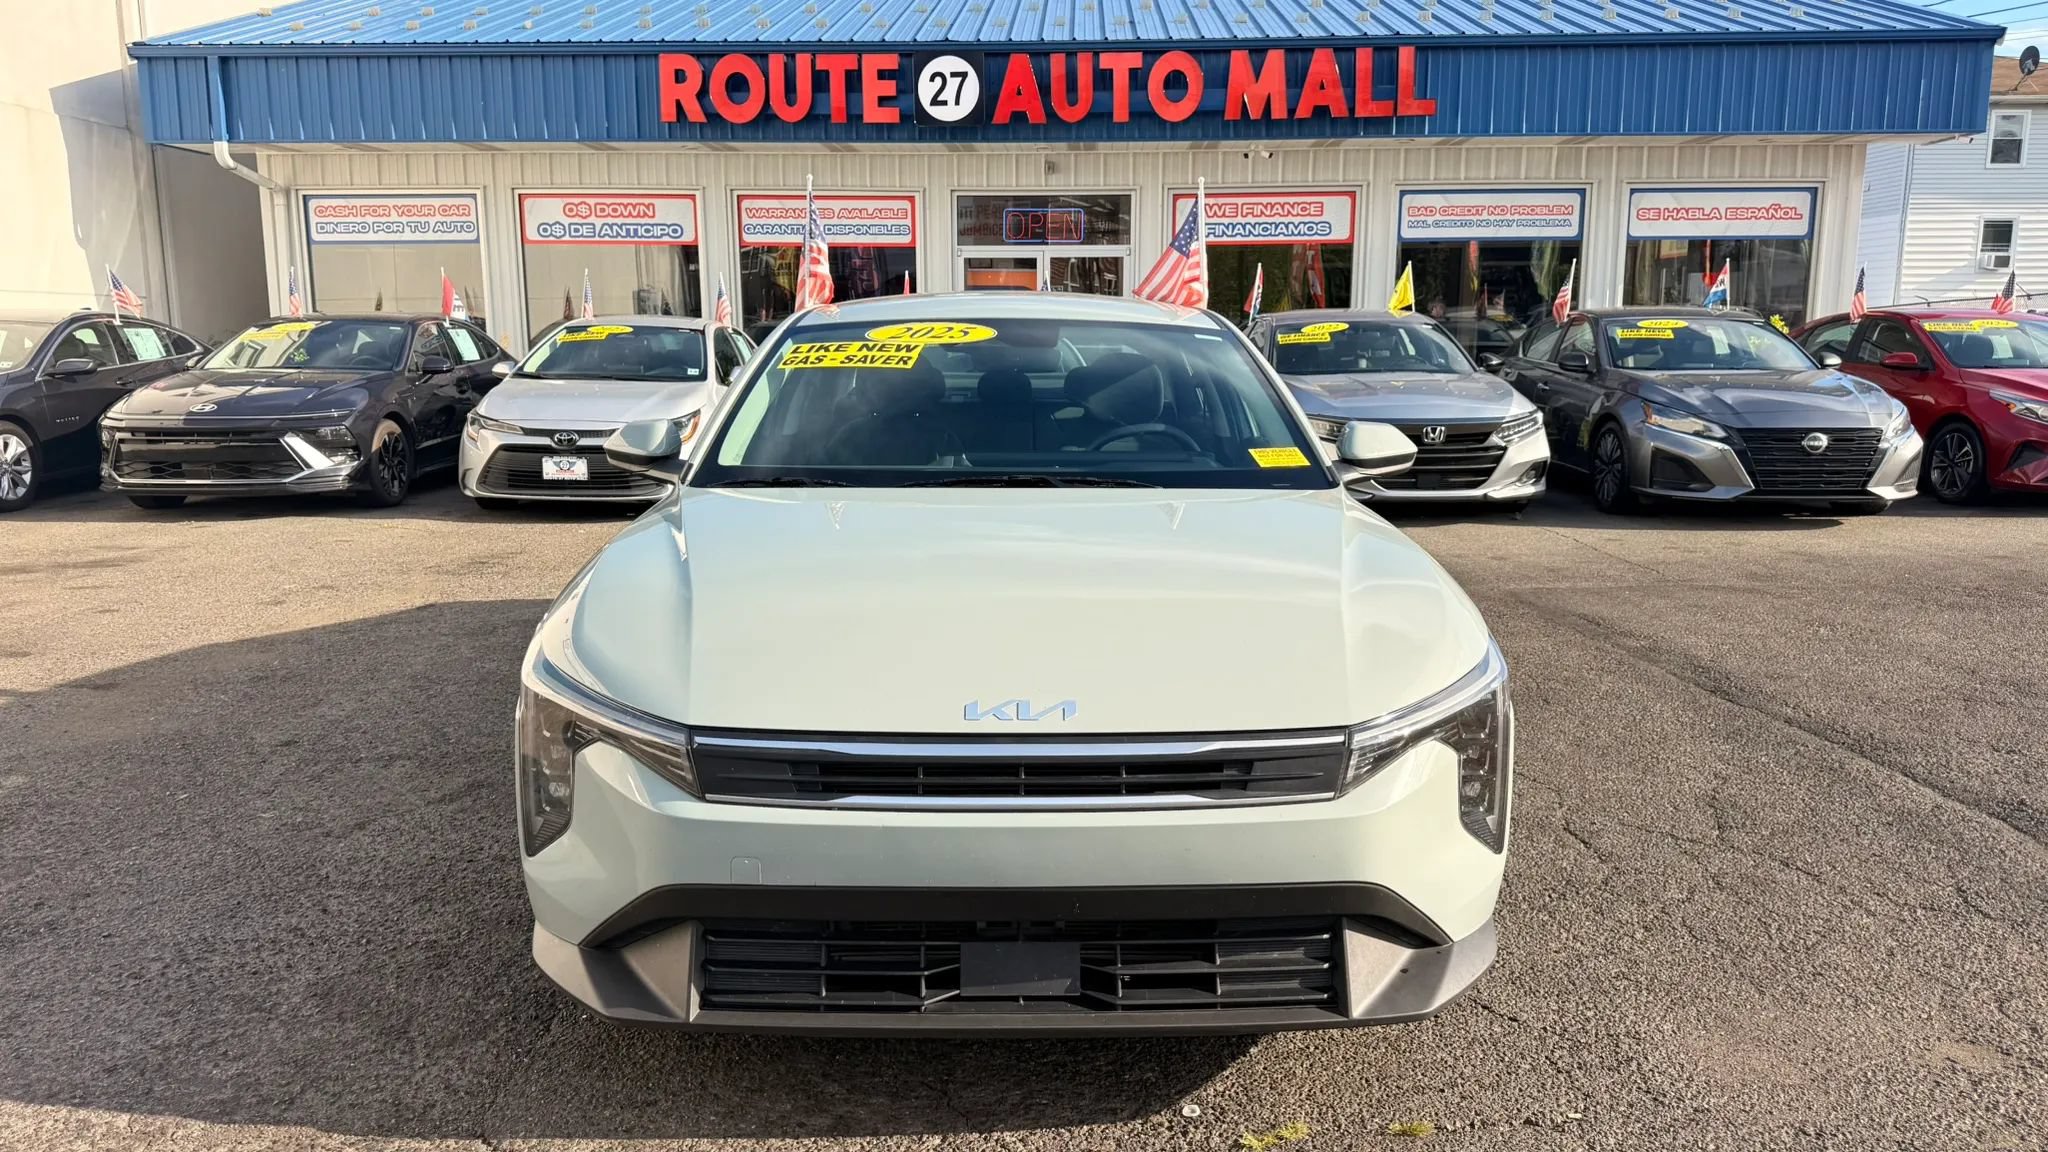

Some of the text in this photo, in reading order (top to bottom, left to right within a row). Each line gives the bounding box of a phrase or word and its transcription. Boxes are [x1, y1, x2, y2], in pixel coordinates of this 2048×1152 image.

[659, 46, 1436, 124] ROUTE 27 AUTO MALL
[314, 204, 471, 218] CASH FOR YOUR CAR
[594, 202, 656, 219] DOWN
[745, 207, 908, 219] WARRANES AVAILABLE
[1204, 201, 1324, 218] WE FINANCE
[1407, 204, 1574, 217] BAD CREDIT NO PROBLEM
[1636, 202, 1803, 221] SE HABLA ESPAÑOL
[316, 220, 476, 234] DINERO POR TU AUTO
[823, 223, 910, 236] DISPONIBLES
[1006, 211, 1082, 240] OPEN
[1205, 220, 1332, 238] FINANCIAMOS
[1407, 219, 1431, 228] MAL
[1476, 219, 1491, 228] NO
[1492, 219, 1515, 228] HAY
[1516, 218, 1572, 228] PROBLEMA
[568, 222, 596, 238] DE
[598, 222, 684, 239] ANTICIPO
[888, 326, 979, 340] 2025
[790, 343, 920, 354] LIKE NEW
